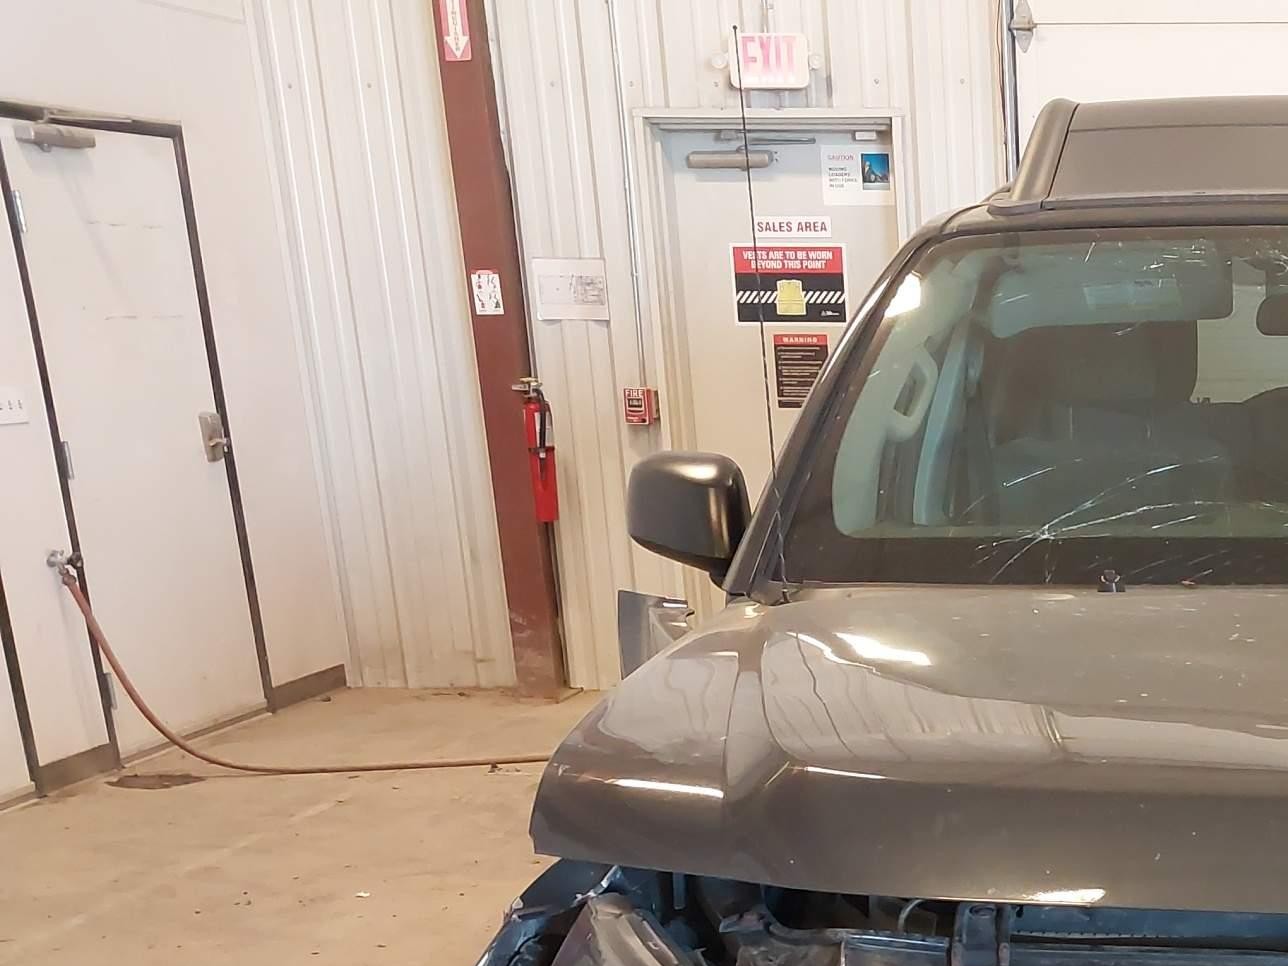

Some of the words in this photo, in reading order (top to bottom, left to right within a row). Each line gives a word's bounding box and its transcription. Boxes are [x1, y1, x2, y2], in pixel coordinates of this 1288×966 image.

[741, 36, 797, 78] EXIT
[757, 221, 793, 233] SALES
[797, 221, 827, 233] AREA
[769, 251, 784, 260] ARE
[785, 251, 796, 260] TO
[797, 251, 808, 260] BE
[809, 251, 832, 260] WORN
[751, 260, 782, 269] BEYOND
[784, 260, 801, 269] THIS
[803, 260, 826, 269] POINT
[625, 389, 643, 398] FIRE
